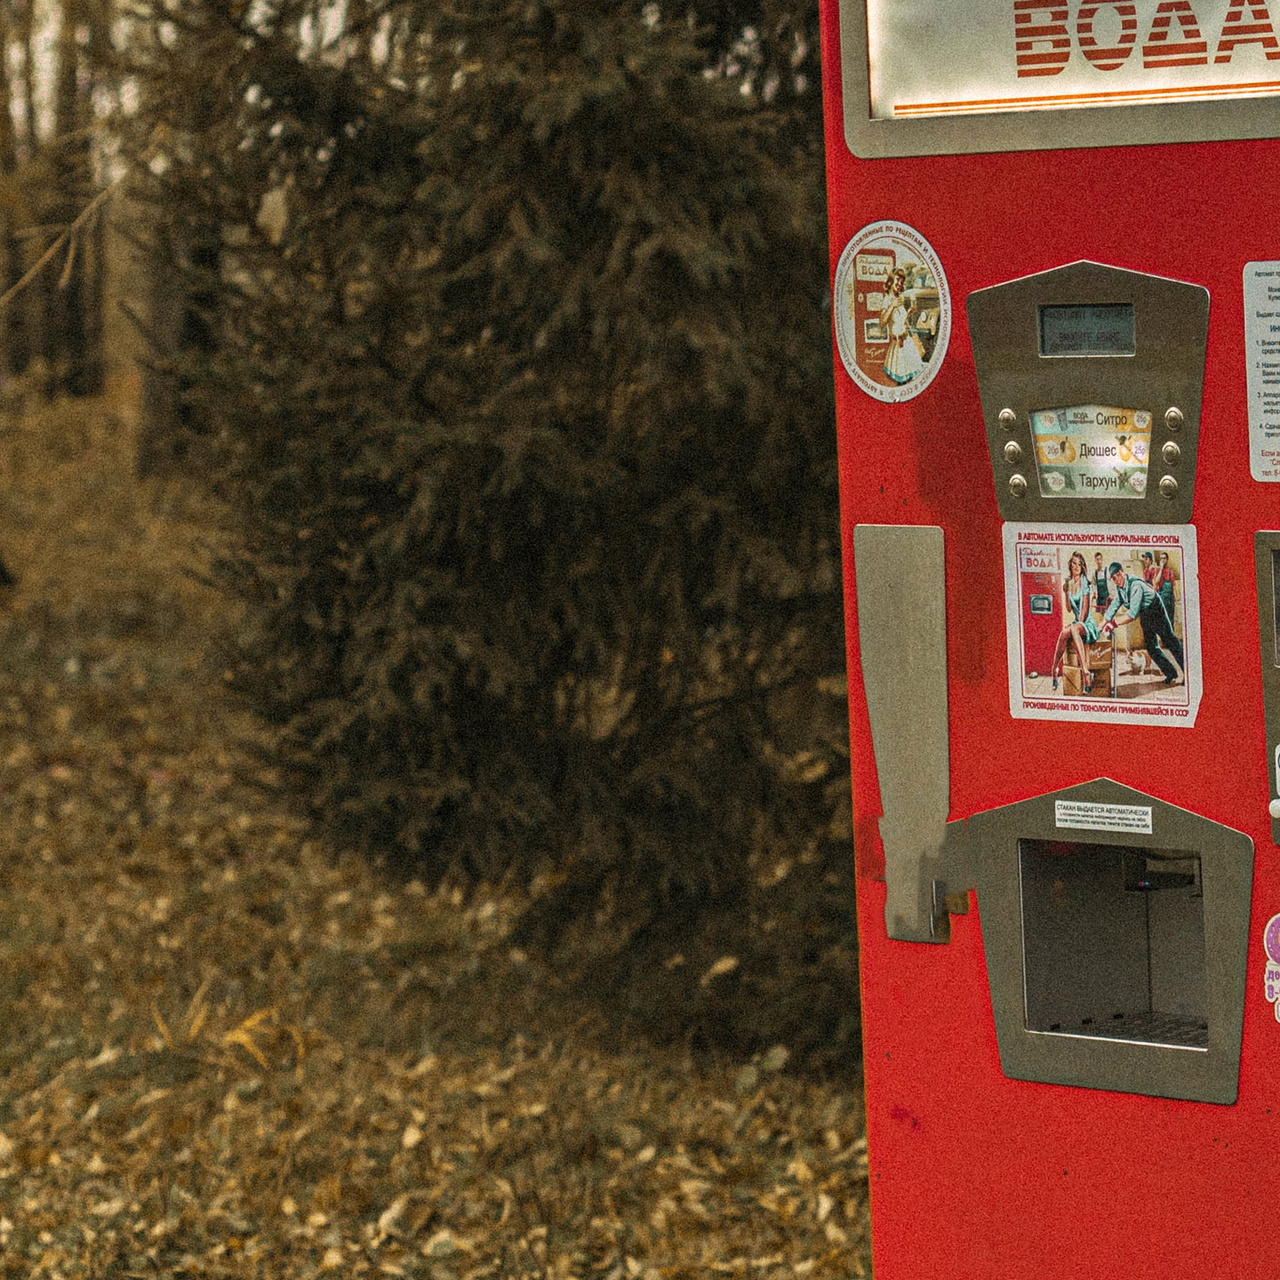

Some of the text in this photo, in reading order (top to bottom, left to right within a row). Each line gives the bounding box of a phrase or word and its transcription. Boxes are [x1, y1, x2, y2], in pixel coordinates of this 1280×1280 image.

[895, 226, 923, 248] РЕЦЕПТАМ
[841, 226, 883, 268] ПРИГОТОВЛЕННЫЕ
[922, 246, 928, 254] И
[862, 265, 889, 275] ВОДА
[928, 254, 948, 305] ТЕХНОЛОГИИ
[851, 368, 877, 394] АВТОМАТЕ
[1096, 412, 1128, 428] Ситро
[1080, 443, 1117, 459] Дюшес
[1079, 473, 1118, 490] Тархун
[1018, 532, 1179, 544] В АВТОМАТЕ ИСПОЛЬЗУЮТСЯ НАТУРАЛЬНЫЕ СИРОПЫ
[1026, 557, 1053, 568] ВОДА
[1023, 701, 1189, 717] ПРОИЗВЕДЕННЫЕ ПО ТЕХНОЛОГИИ ПРИМЕНЯВШЕЙСЯ В СССР
[1057, 803, 1149, 817] СТАКАН ВЫДАЕТСЯ АВТОМАТИЧЕСКИ
